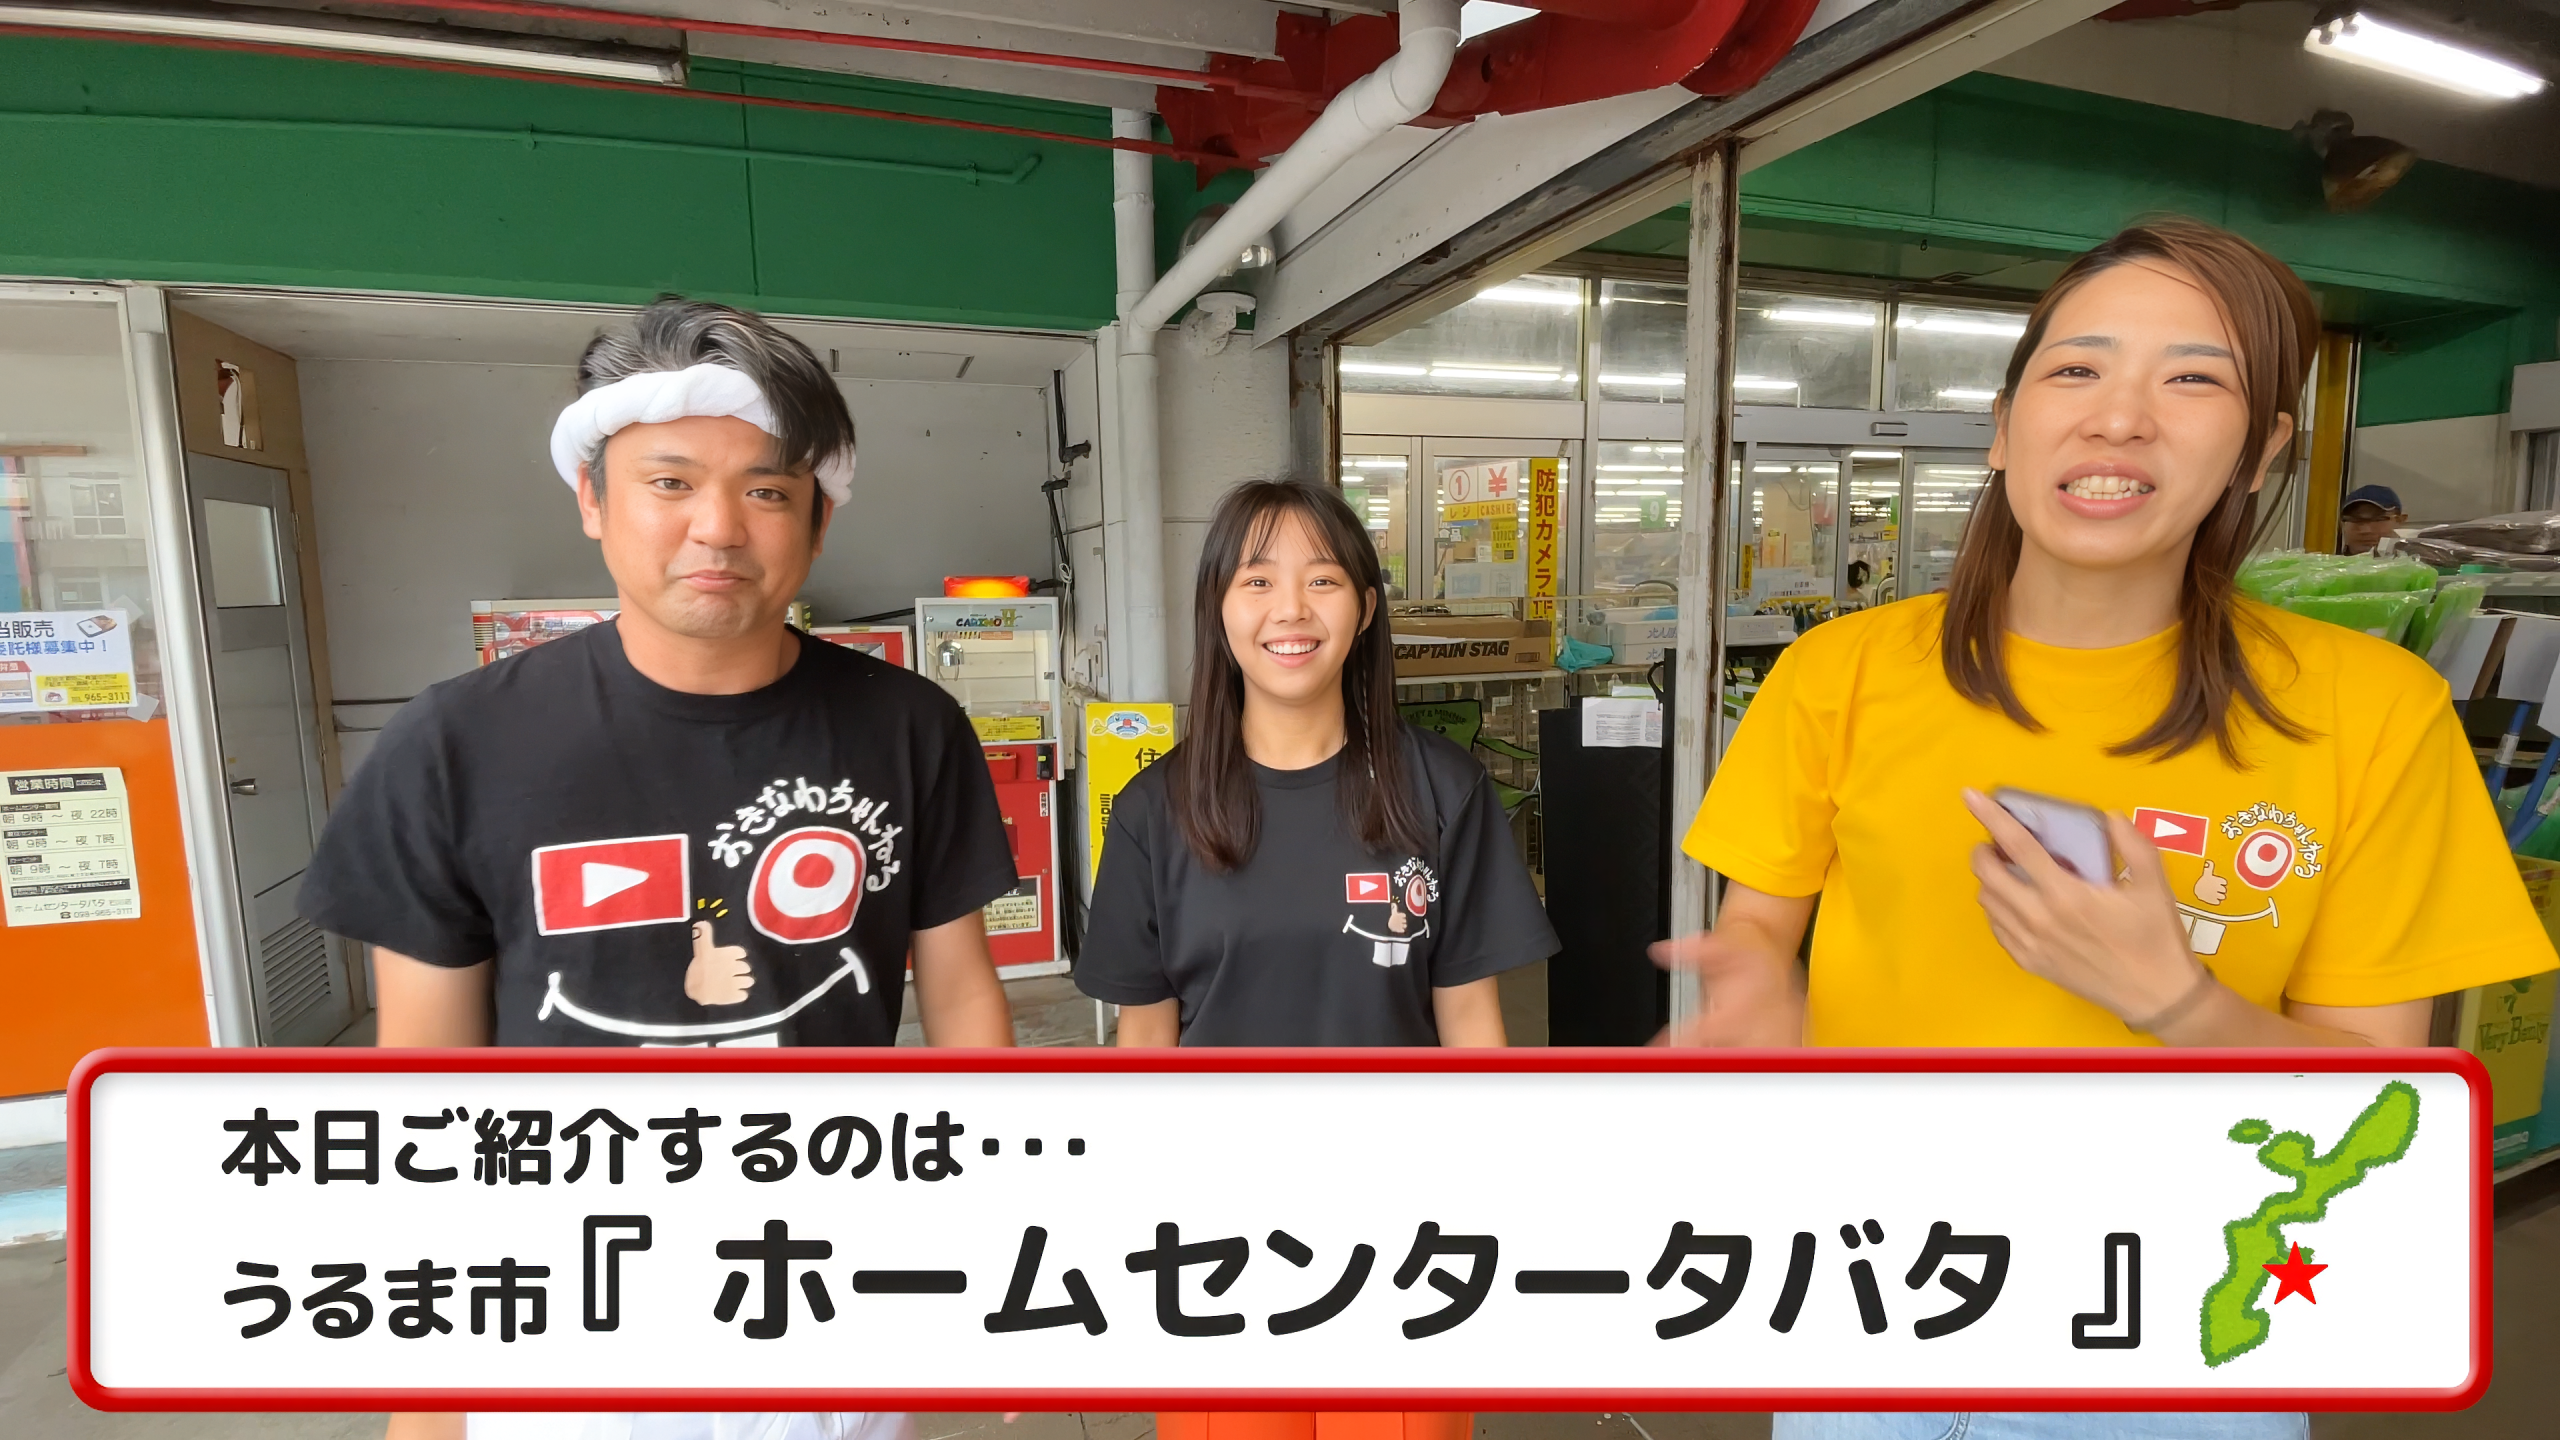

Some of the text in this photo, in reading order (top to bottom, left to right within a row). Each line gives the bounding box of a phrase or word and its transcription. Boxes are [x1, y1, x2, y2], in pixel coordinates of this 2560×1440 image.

[1395, 641, 1510, 659] CAPTAIN STAG
[84, 692, 131, 702] 965-3111
